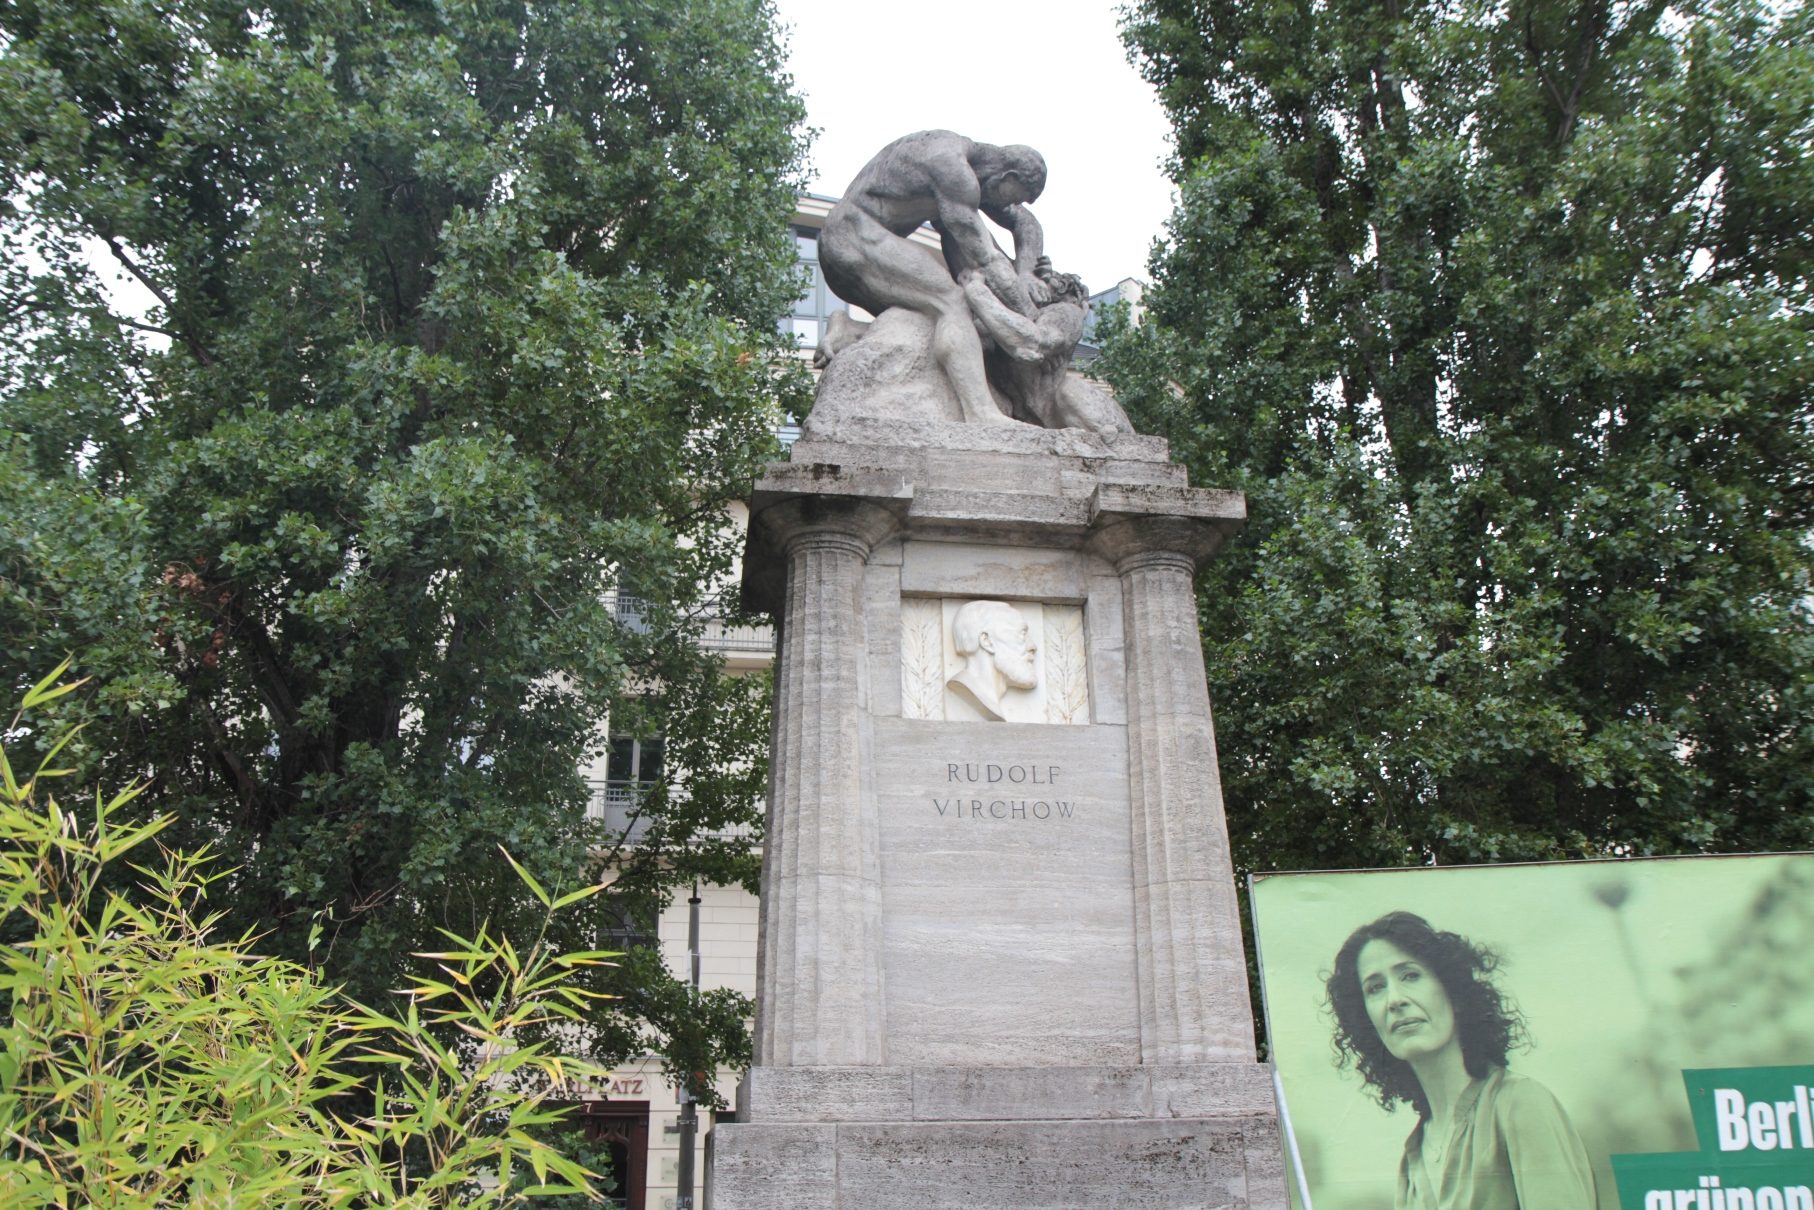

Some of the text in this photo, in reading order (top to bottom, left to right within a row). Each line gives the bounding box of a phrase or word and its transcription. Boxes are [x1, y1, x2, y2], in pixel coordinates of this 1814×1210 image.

[947, 763, 1061, 784] RUDOLF
[933, 799, 1075, 819] VIRCHOW
[537, 1079, 643, 1095] RLATZ
[584, 1102, 592, 1114] 7
